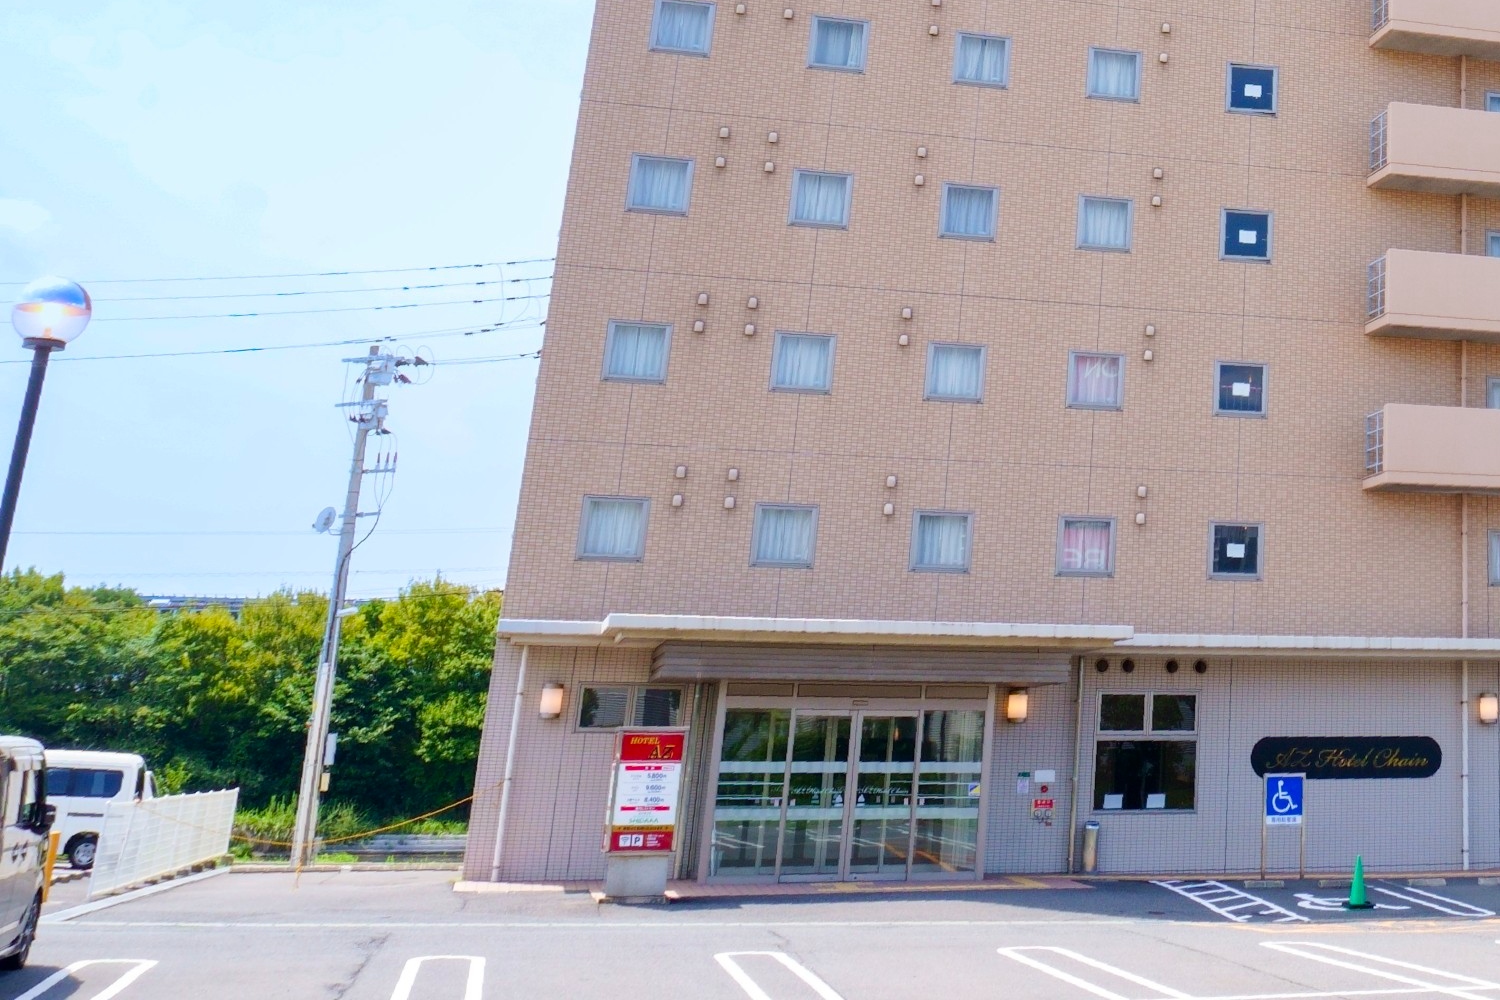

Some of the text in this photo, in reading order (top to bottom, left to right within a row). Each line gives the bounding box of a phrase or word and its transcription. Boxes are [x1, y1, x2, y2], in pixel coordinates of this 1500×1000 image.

[630, 736, 661, 745] HOTEL
[648, 745, 676, 759] AZ
[1266, 747, 1429, 769] AZ Hotel Chain
